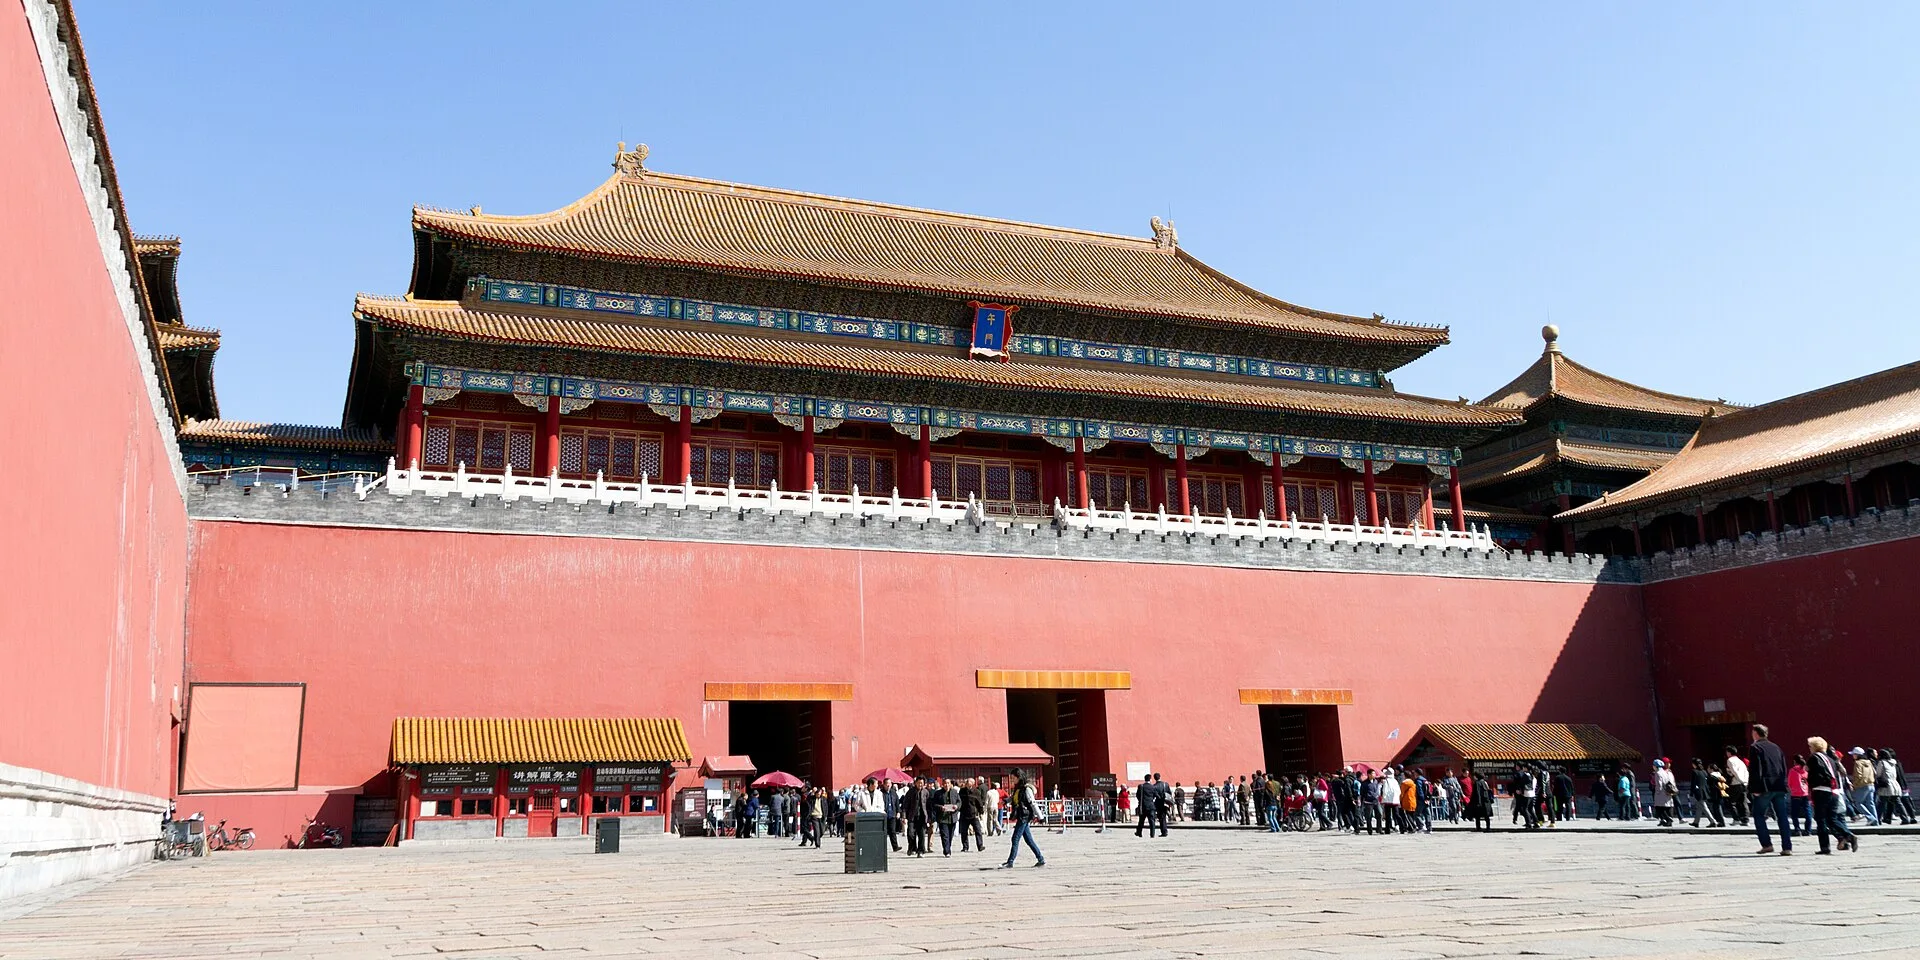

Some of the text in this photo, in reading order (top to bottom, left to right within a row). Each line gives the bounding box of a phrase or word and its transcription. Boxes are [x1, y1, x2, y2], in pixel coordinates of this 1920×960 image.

[648, 766, 661, 774] Guide
[512, 771, 578, 779] 讲解服务处
